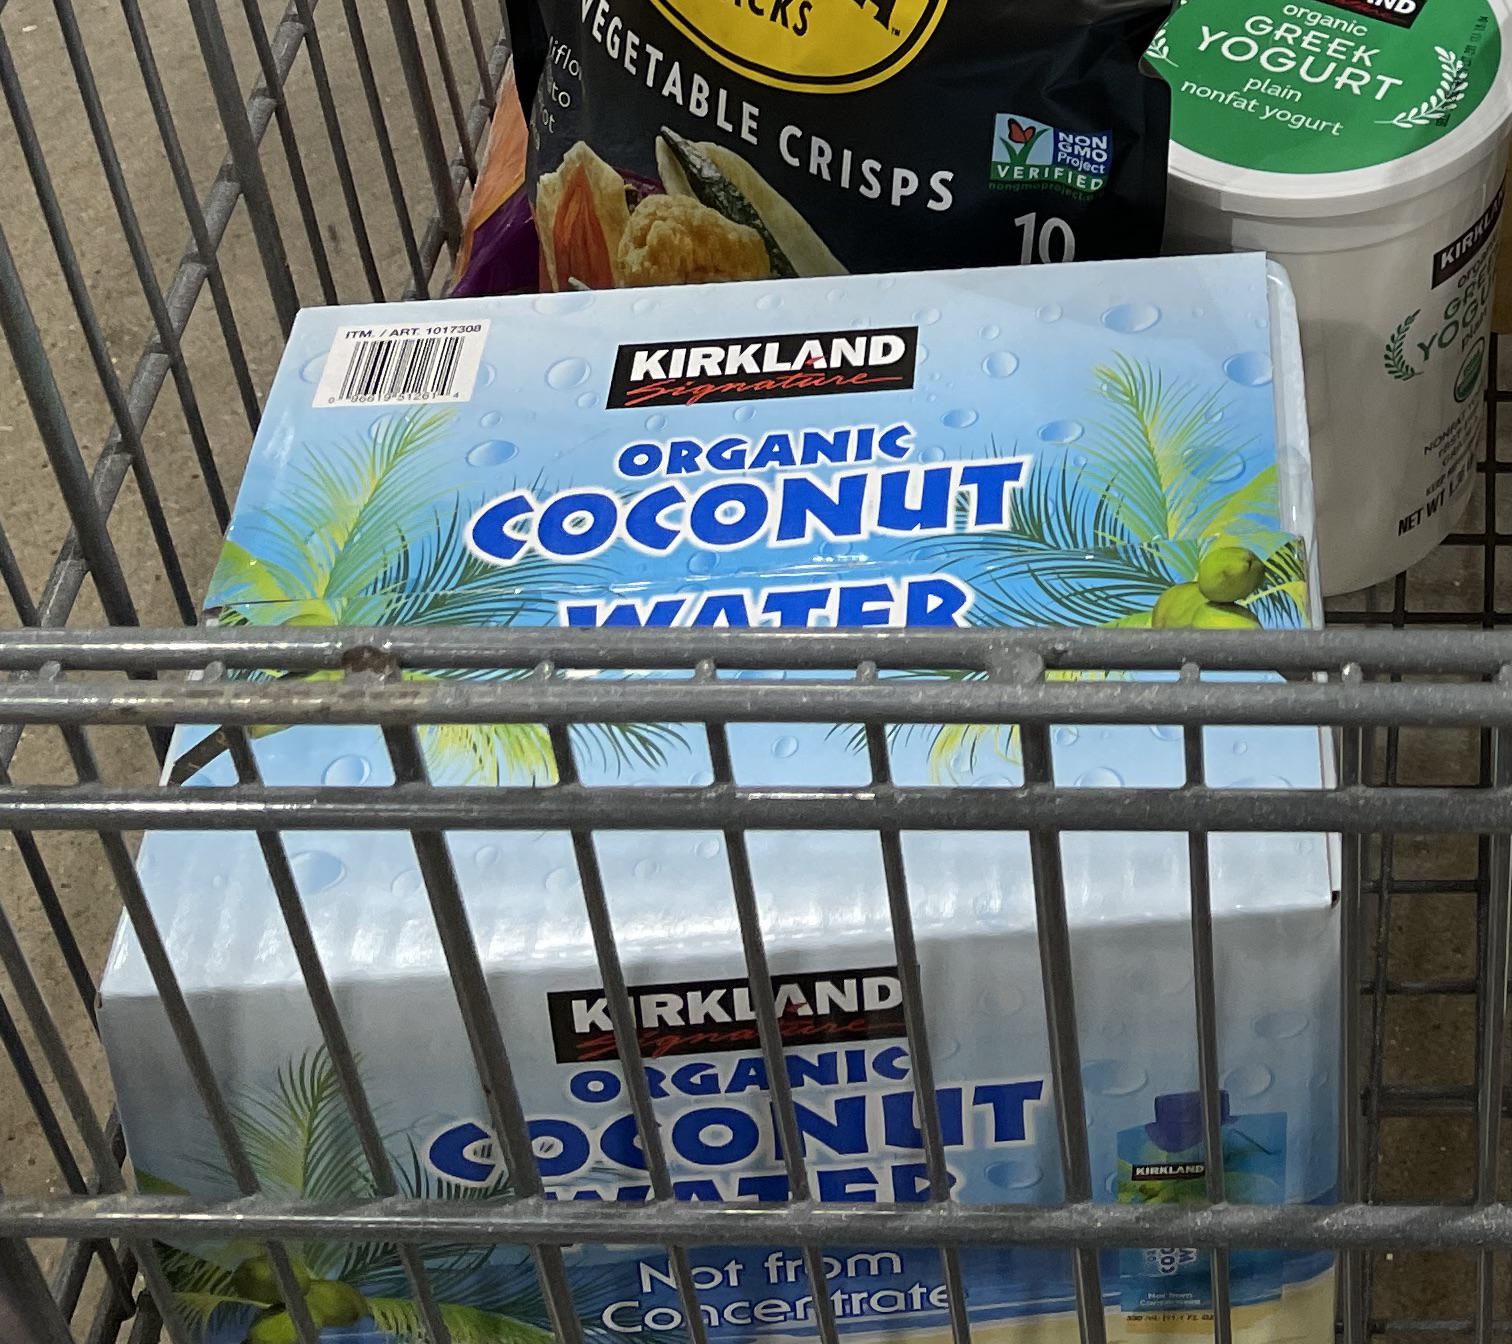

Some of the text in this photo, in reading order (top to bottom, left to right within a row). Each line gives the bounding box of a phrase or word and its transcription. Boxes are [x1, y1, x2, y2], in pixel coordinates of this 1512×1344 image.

[1243, 15, 1381, 68] GREEK
[1282, 2, 1369, 39] organic
[1195, 25, 1404, 102] YOGURT
[1179, 77, 1344, 137] nonfat yogurt
[1243, 76, 1303, 104] plain
[1057, 141, 1108, 162] GMO
[1057, 151, 1106, 175] Project
[1058, 131, 1108, 150] NON
[777, 123, 956, 213] CRISPS
[996, 164, 1104, 191] VERIFIED
[1013, 211, 1076, 265] 10
[426, 324, 482, 336] 1017308
[628, 332, 908, 383] KIRKLAND
[624, 367, 906, 407] Signature
[616, 422, 913, 480] ORGANIC
[468, 459, 1030, 562] COCONUT
[572, 975, 906, 1036] KIRKLAND
[568, 1045, 912, 1103] ORGANIC
[427, 1079, 1045, 1183] COCONUT
[1135, 1164, 1204, 1177] KIRKLAND
[638, 1259, 743, 1296] Not
